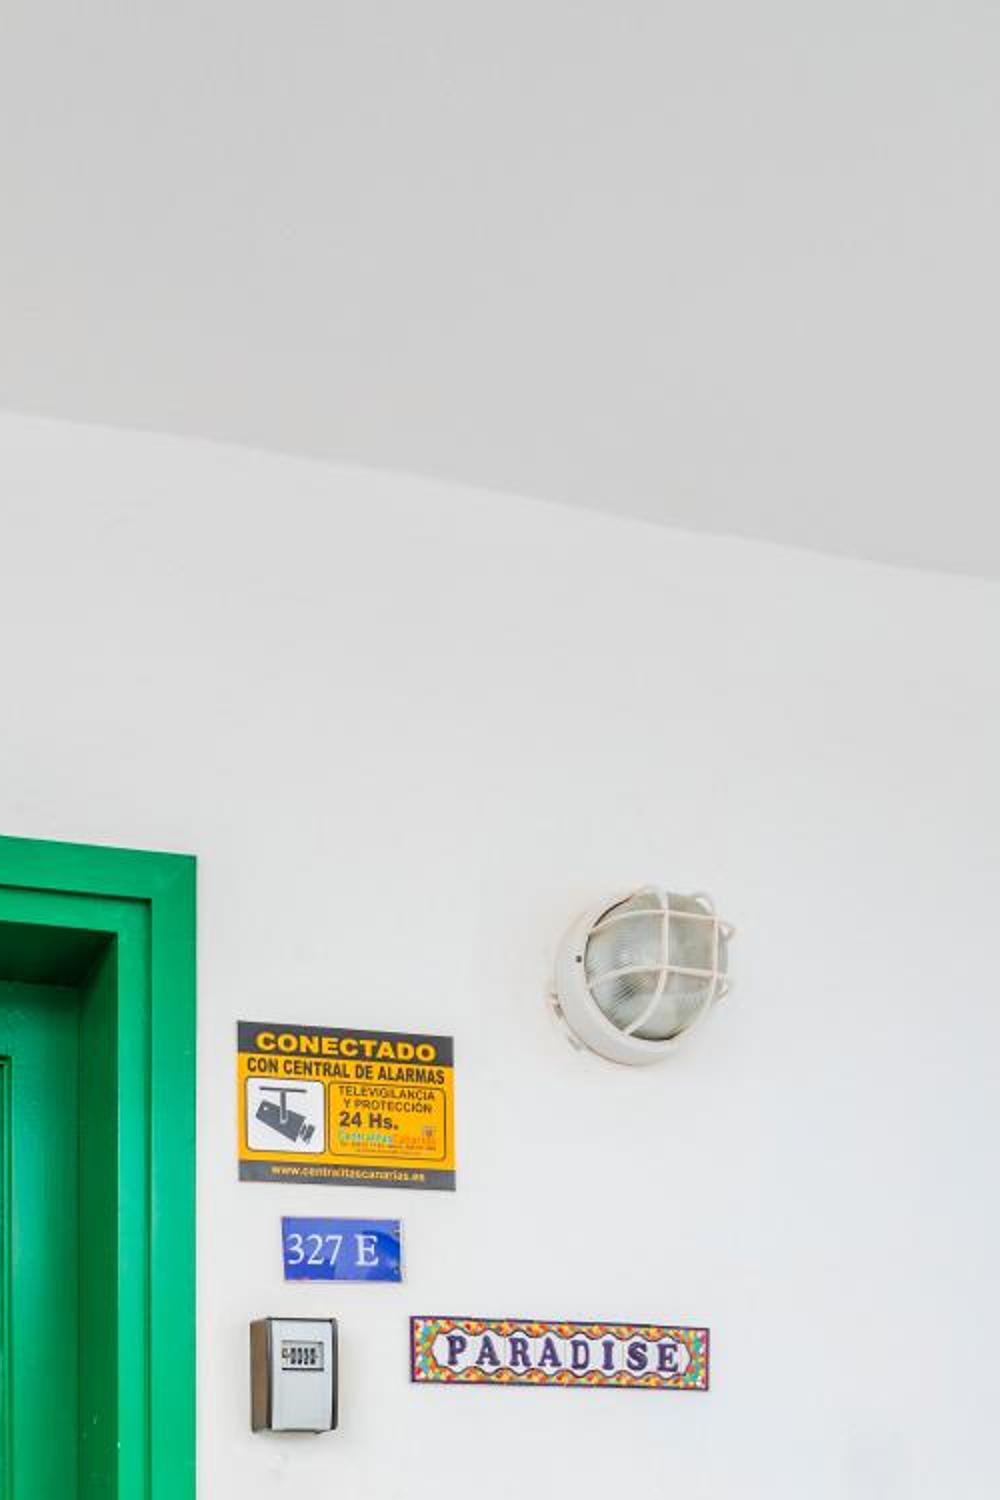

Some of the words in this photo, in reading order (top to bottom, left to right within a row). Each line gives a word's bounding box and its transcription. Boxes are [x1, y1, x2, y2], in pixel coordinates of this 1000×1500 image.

[255, 1031, 437, 1062] CONECTADO
[247, 1057, 279, 1073] CON
[283, 1060, 350, 1078] CENTRAL
[355, 1065, 372, 1080] DE
[377, 1066, 445, 1085] ALARMAS
[338, 1085, 435, 1101] TELEVIGILANCIA
[343, 1098, 350, 1109] Y
[353, 1099, 433, 1113] PROTECCIÓN
[339, 1111, 362, 1127] 24
[368, 1113, 398, 1130] Hs.
[286, 1233, 343, 1266] 327
[354, 1234, 379, 1266] E
[446, 1329, 679, 1373] PARADISE
